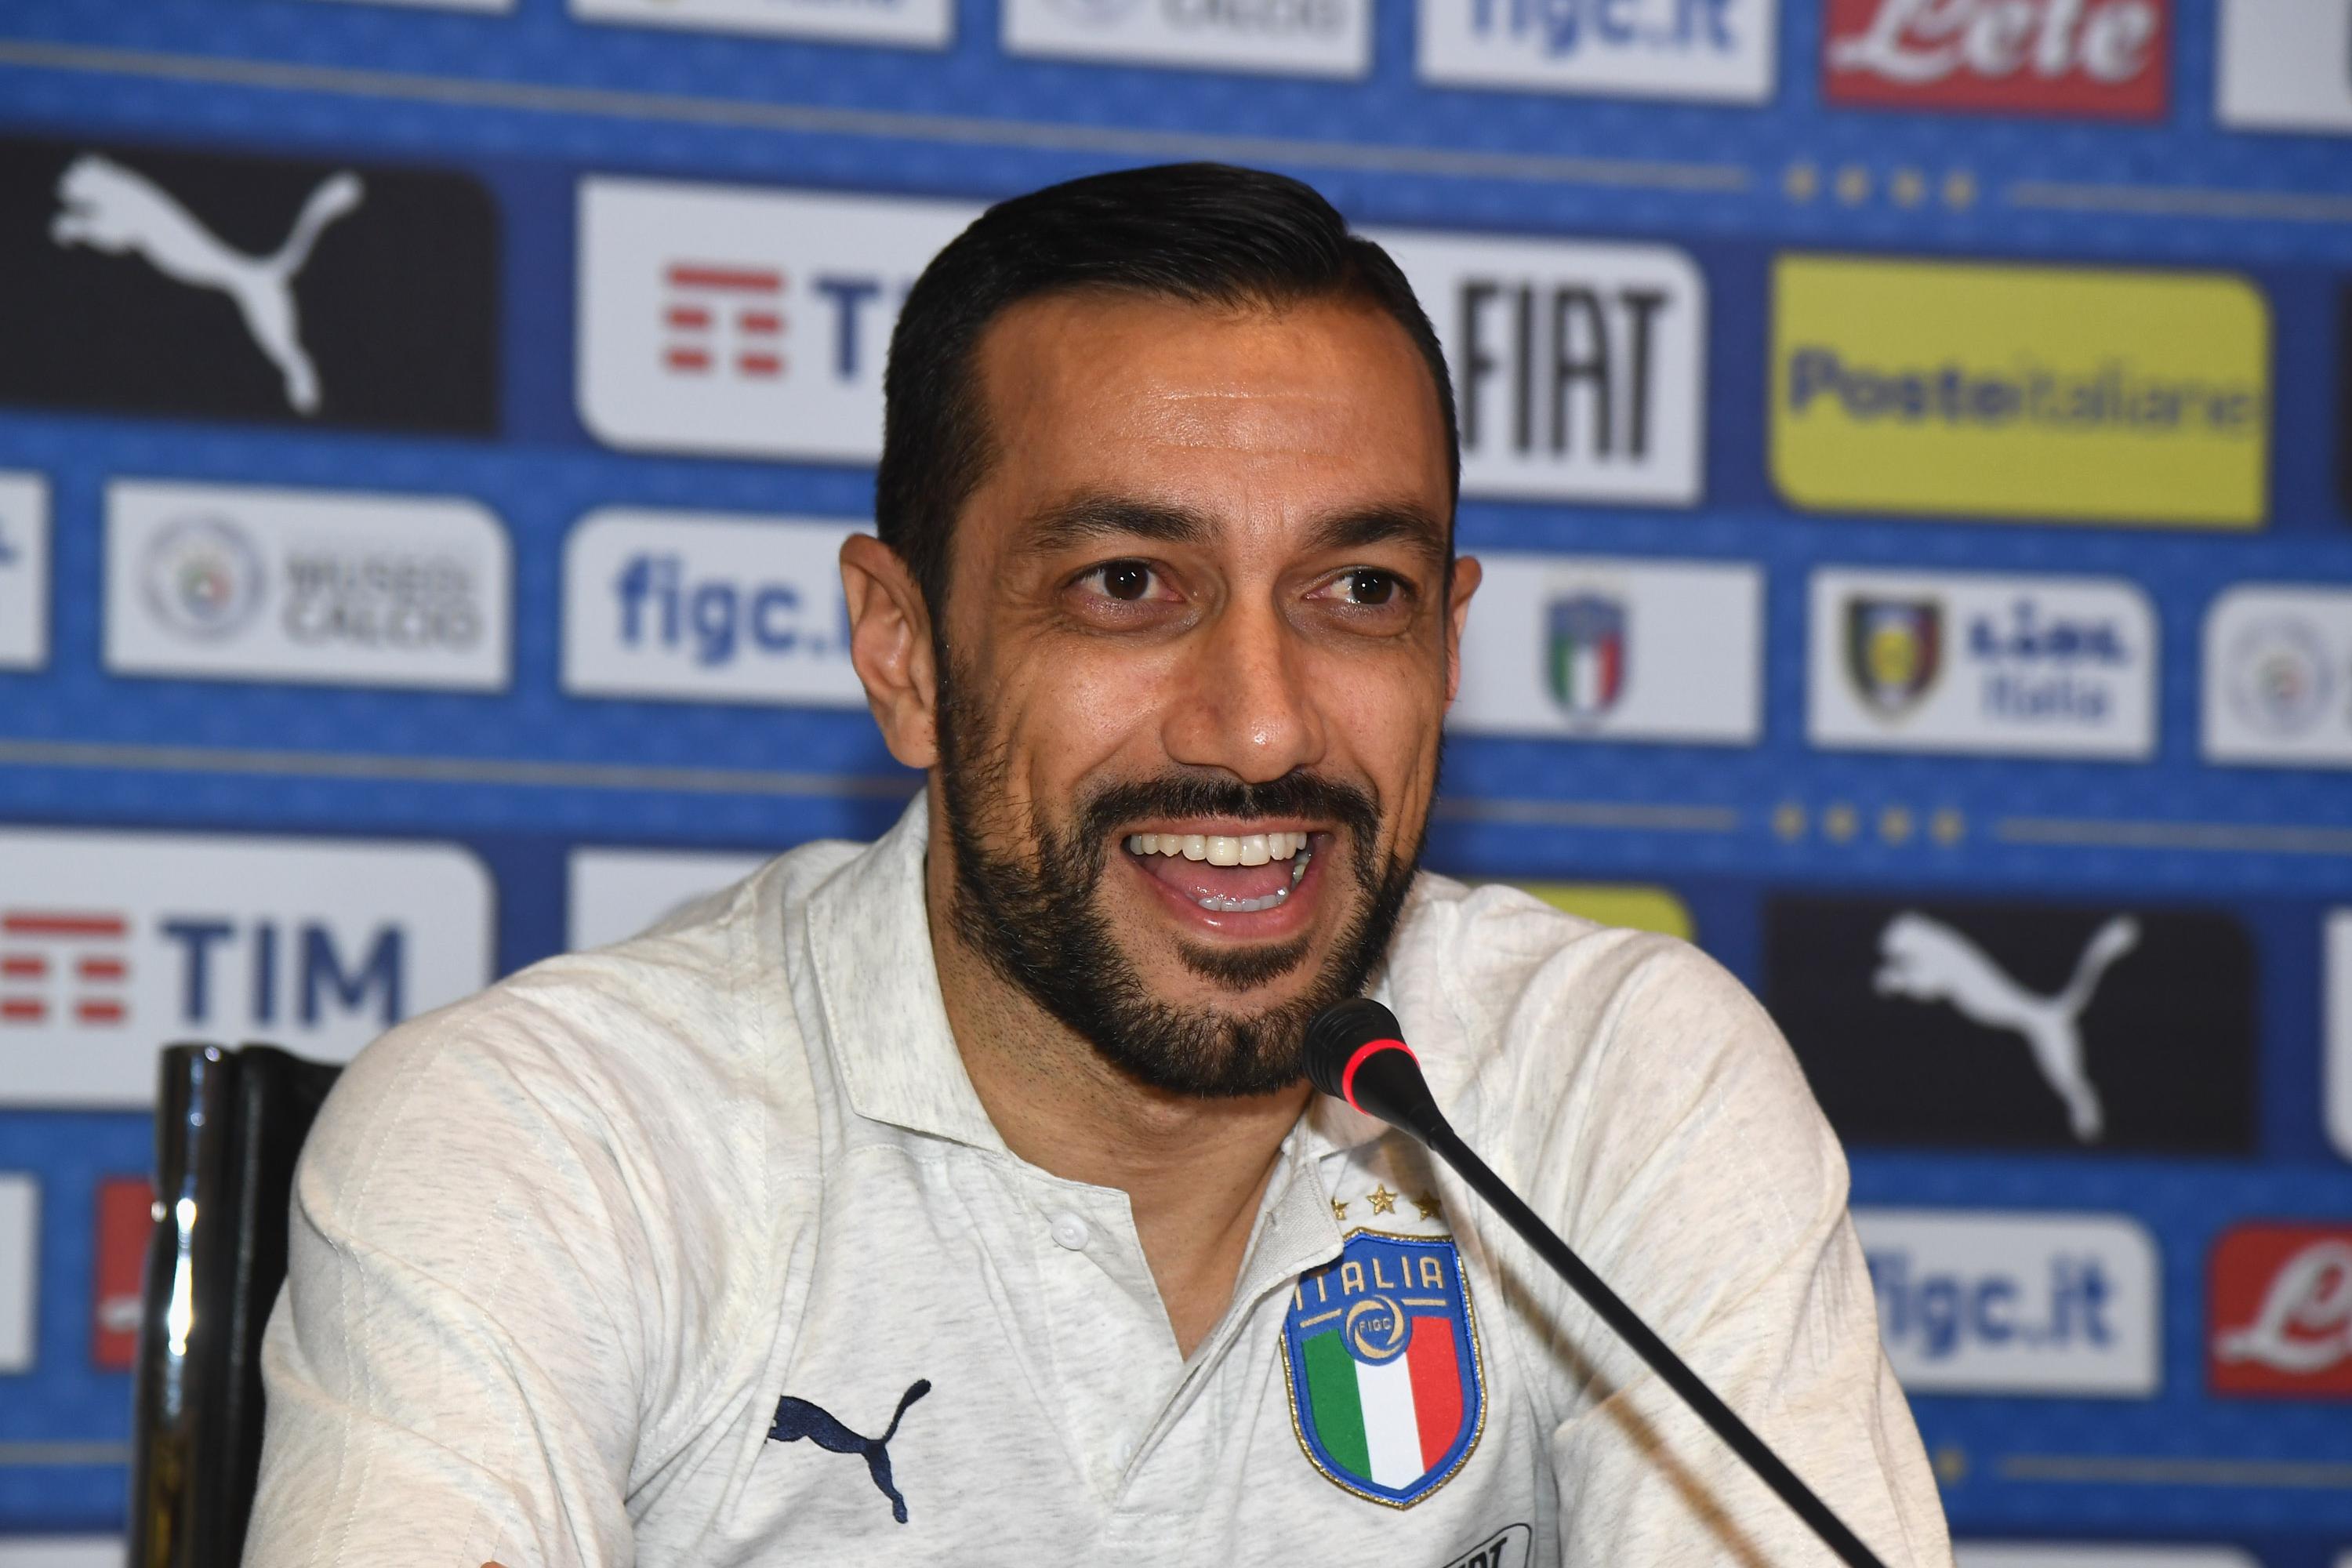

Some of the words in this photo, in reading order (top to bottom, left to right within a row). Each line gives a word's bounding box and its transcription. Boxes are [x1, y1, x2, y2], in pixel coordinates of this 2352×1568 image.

[1457, 279, 1671, 461] FIAT
[158, 913, 408, 1031] TIM
[1295, 1256, 1444, 1311] ITALIA
